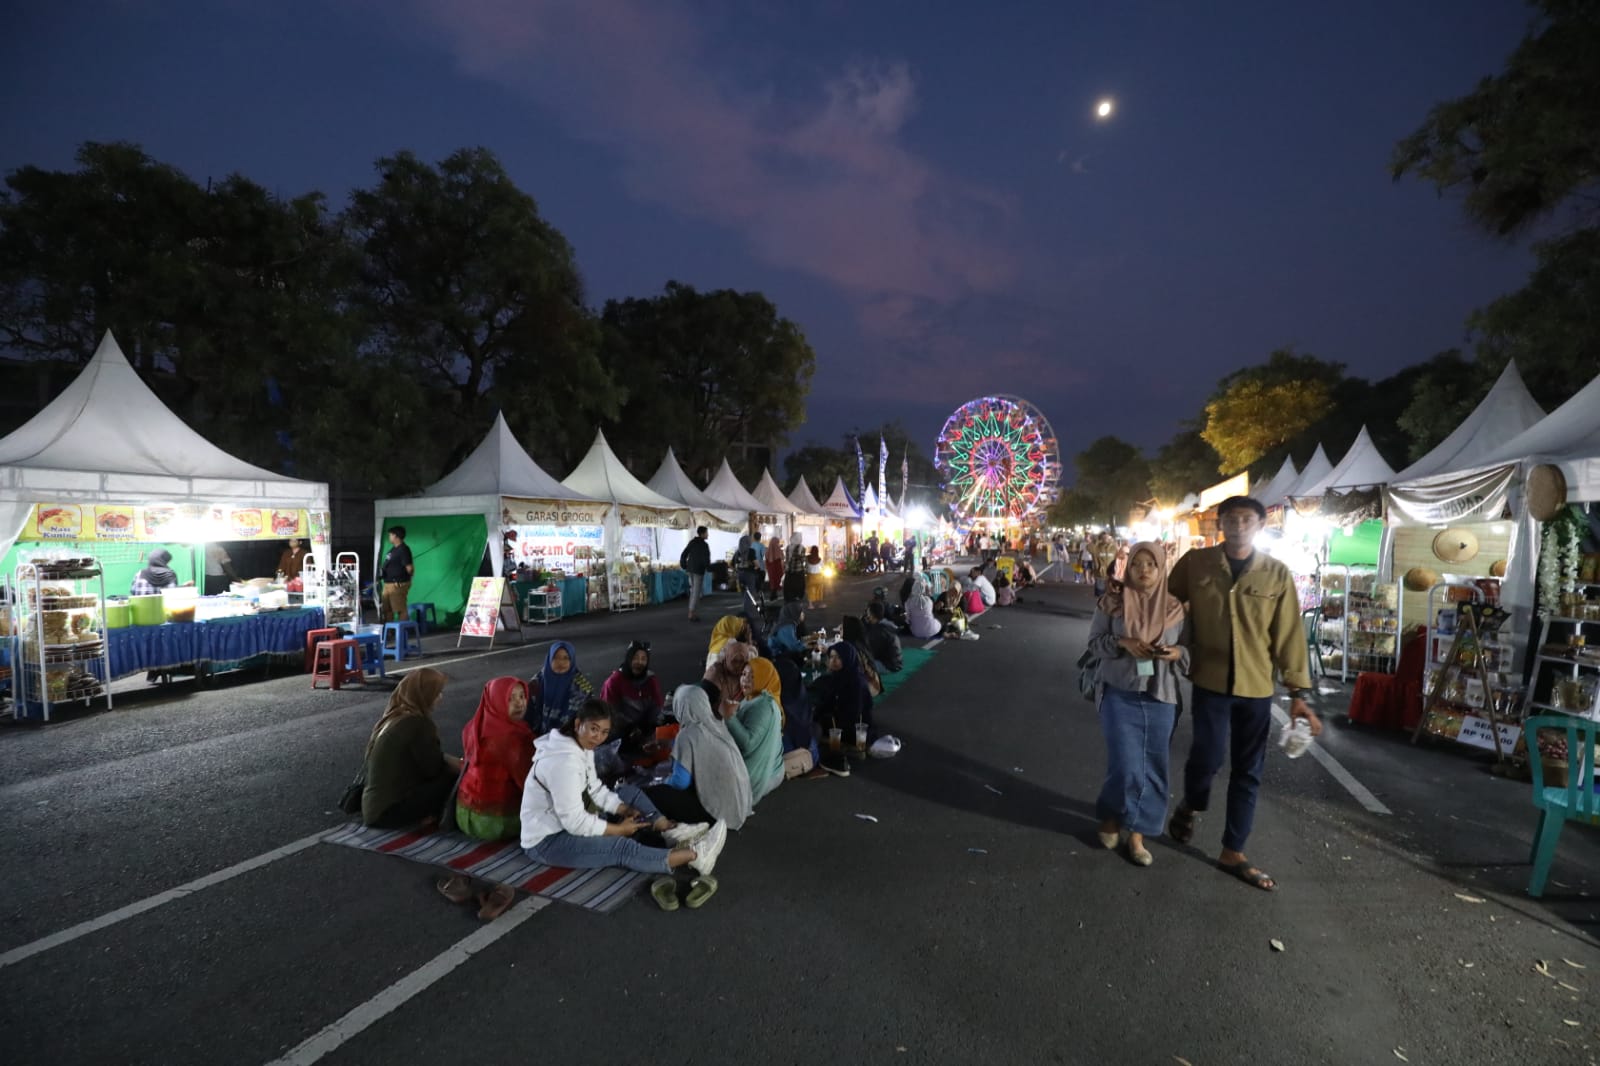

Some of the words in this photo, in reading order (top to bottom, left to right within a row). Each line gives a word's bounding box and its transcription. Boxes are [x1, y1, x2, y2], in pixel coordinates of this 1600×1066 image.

[526, 511, 559, 521] GARASI
[561, 511, 594, 522] GROGOL
[1474, 721, 1508, 734] SERA
